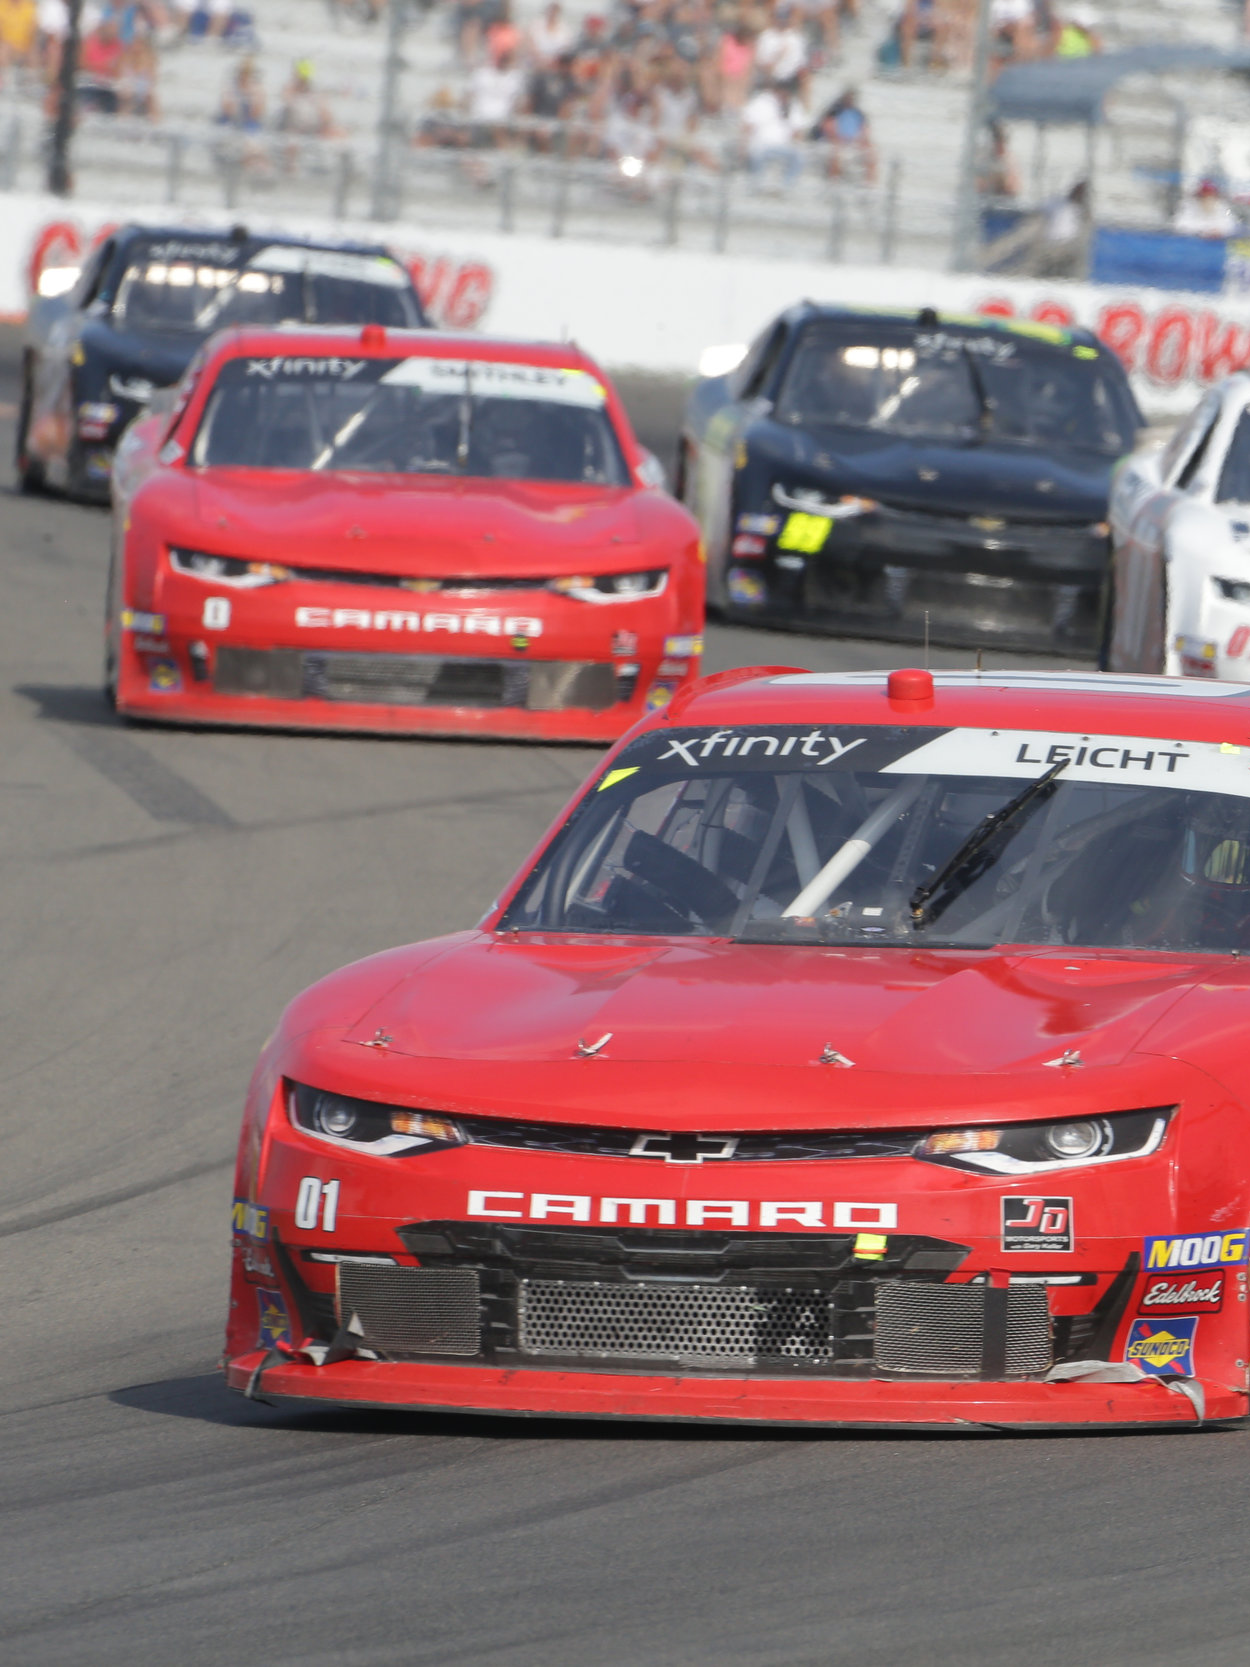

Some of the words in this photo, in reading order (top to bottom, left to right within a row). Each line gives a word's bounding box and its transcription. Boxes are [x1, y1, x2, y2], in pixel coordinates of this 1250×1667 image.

[247, 356, 367, 380] xfinity
[203, 596, 231, 631] 0
[295, 606, 543, 638] CAMARO
[656, 728, 868, 766] xfinity
[1015, 742, 1190, 773] LEICHT
[294, 1175, 341, 1233] 01
[466, 1189, 899, 1229] CAMARO
[1146, 1233, 1246, 1269] MOOG
[1142, 1279, 1222, 1306] Edelbrock
[1130, 1339, 1189, 1357] SUNOCO
